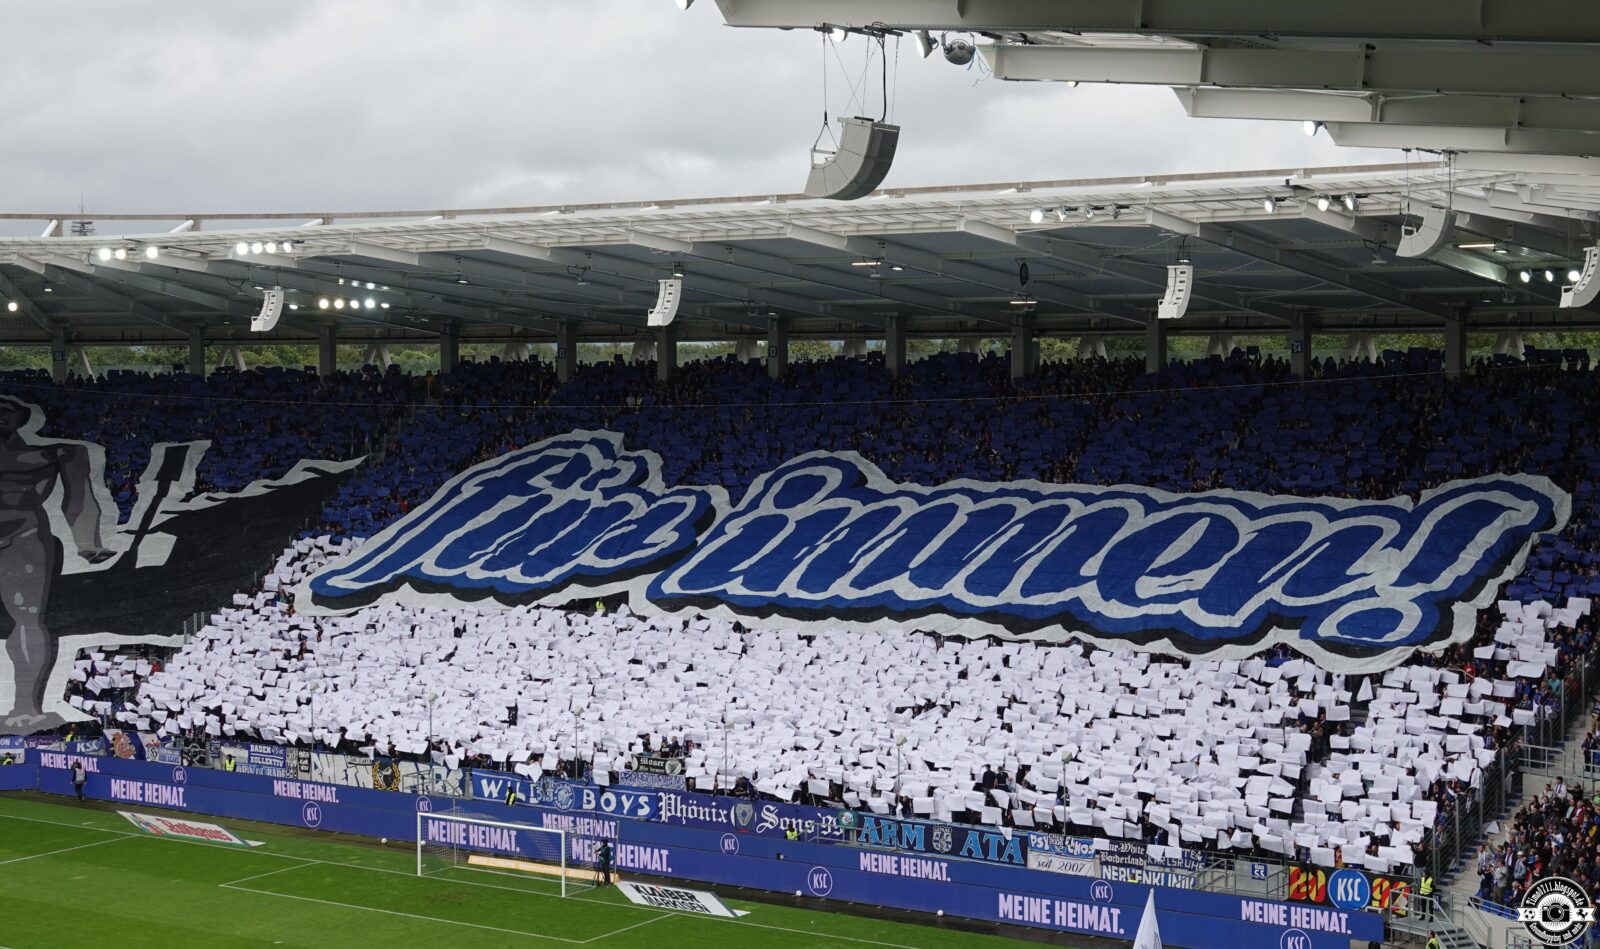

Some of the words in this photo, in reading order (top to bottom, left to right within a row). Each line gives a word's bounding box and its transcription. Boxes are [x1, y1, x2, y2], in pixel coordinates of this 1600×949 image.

[76, 740, 99, 752] KSC
[41, 753, 66, 769] MEINE
[68, 756, 99, 773] HMAT.
[111, 779, 142, 800] MEINE
[145, 783, 186, 807] HEIMAT.
[274, 780, 301, 798] MEINE
[303, 783, 339, 803] HEIMAT.
[582, 789, 651, 816] BOYS
[307, 807, 317, 820] KSC
[420, 801, 429, 811] KSC
[658, 792, 728, 824] Phönix
[756, 805, 815, 834] Sons
[428, 820, 467, 845] MEINE
[469, 825, 520, 852] HEIMAT.
[543, 813, 576, 832] MEINE
[577, 816, 618, 839] HEIMAT.
[725, 839, 735, 850] KSC
[960, 830, 1024, 864] ATA
[616, 843, 672, 872] HEIMAT.
[860, 853, 898, 875] MEINE
[901, 858, 951, 882] HEIMAT.
[1058, 862, 1086, 873] 2007
[814, 874, 827, 888] KSC
[1096, 886, 1108, 898] KSC
[1337, 878, 1362, 902] KSC
[642, 895, 712, 914] MARKISEN
[998, 893, 1050, 924] MEINE
[1055, 901, 1125, 934] HEIMAT.
[1241, 900, 1288, 926] MEINE
[1290, 906, 1352, 934] HEIMAT.
